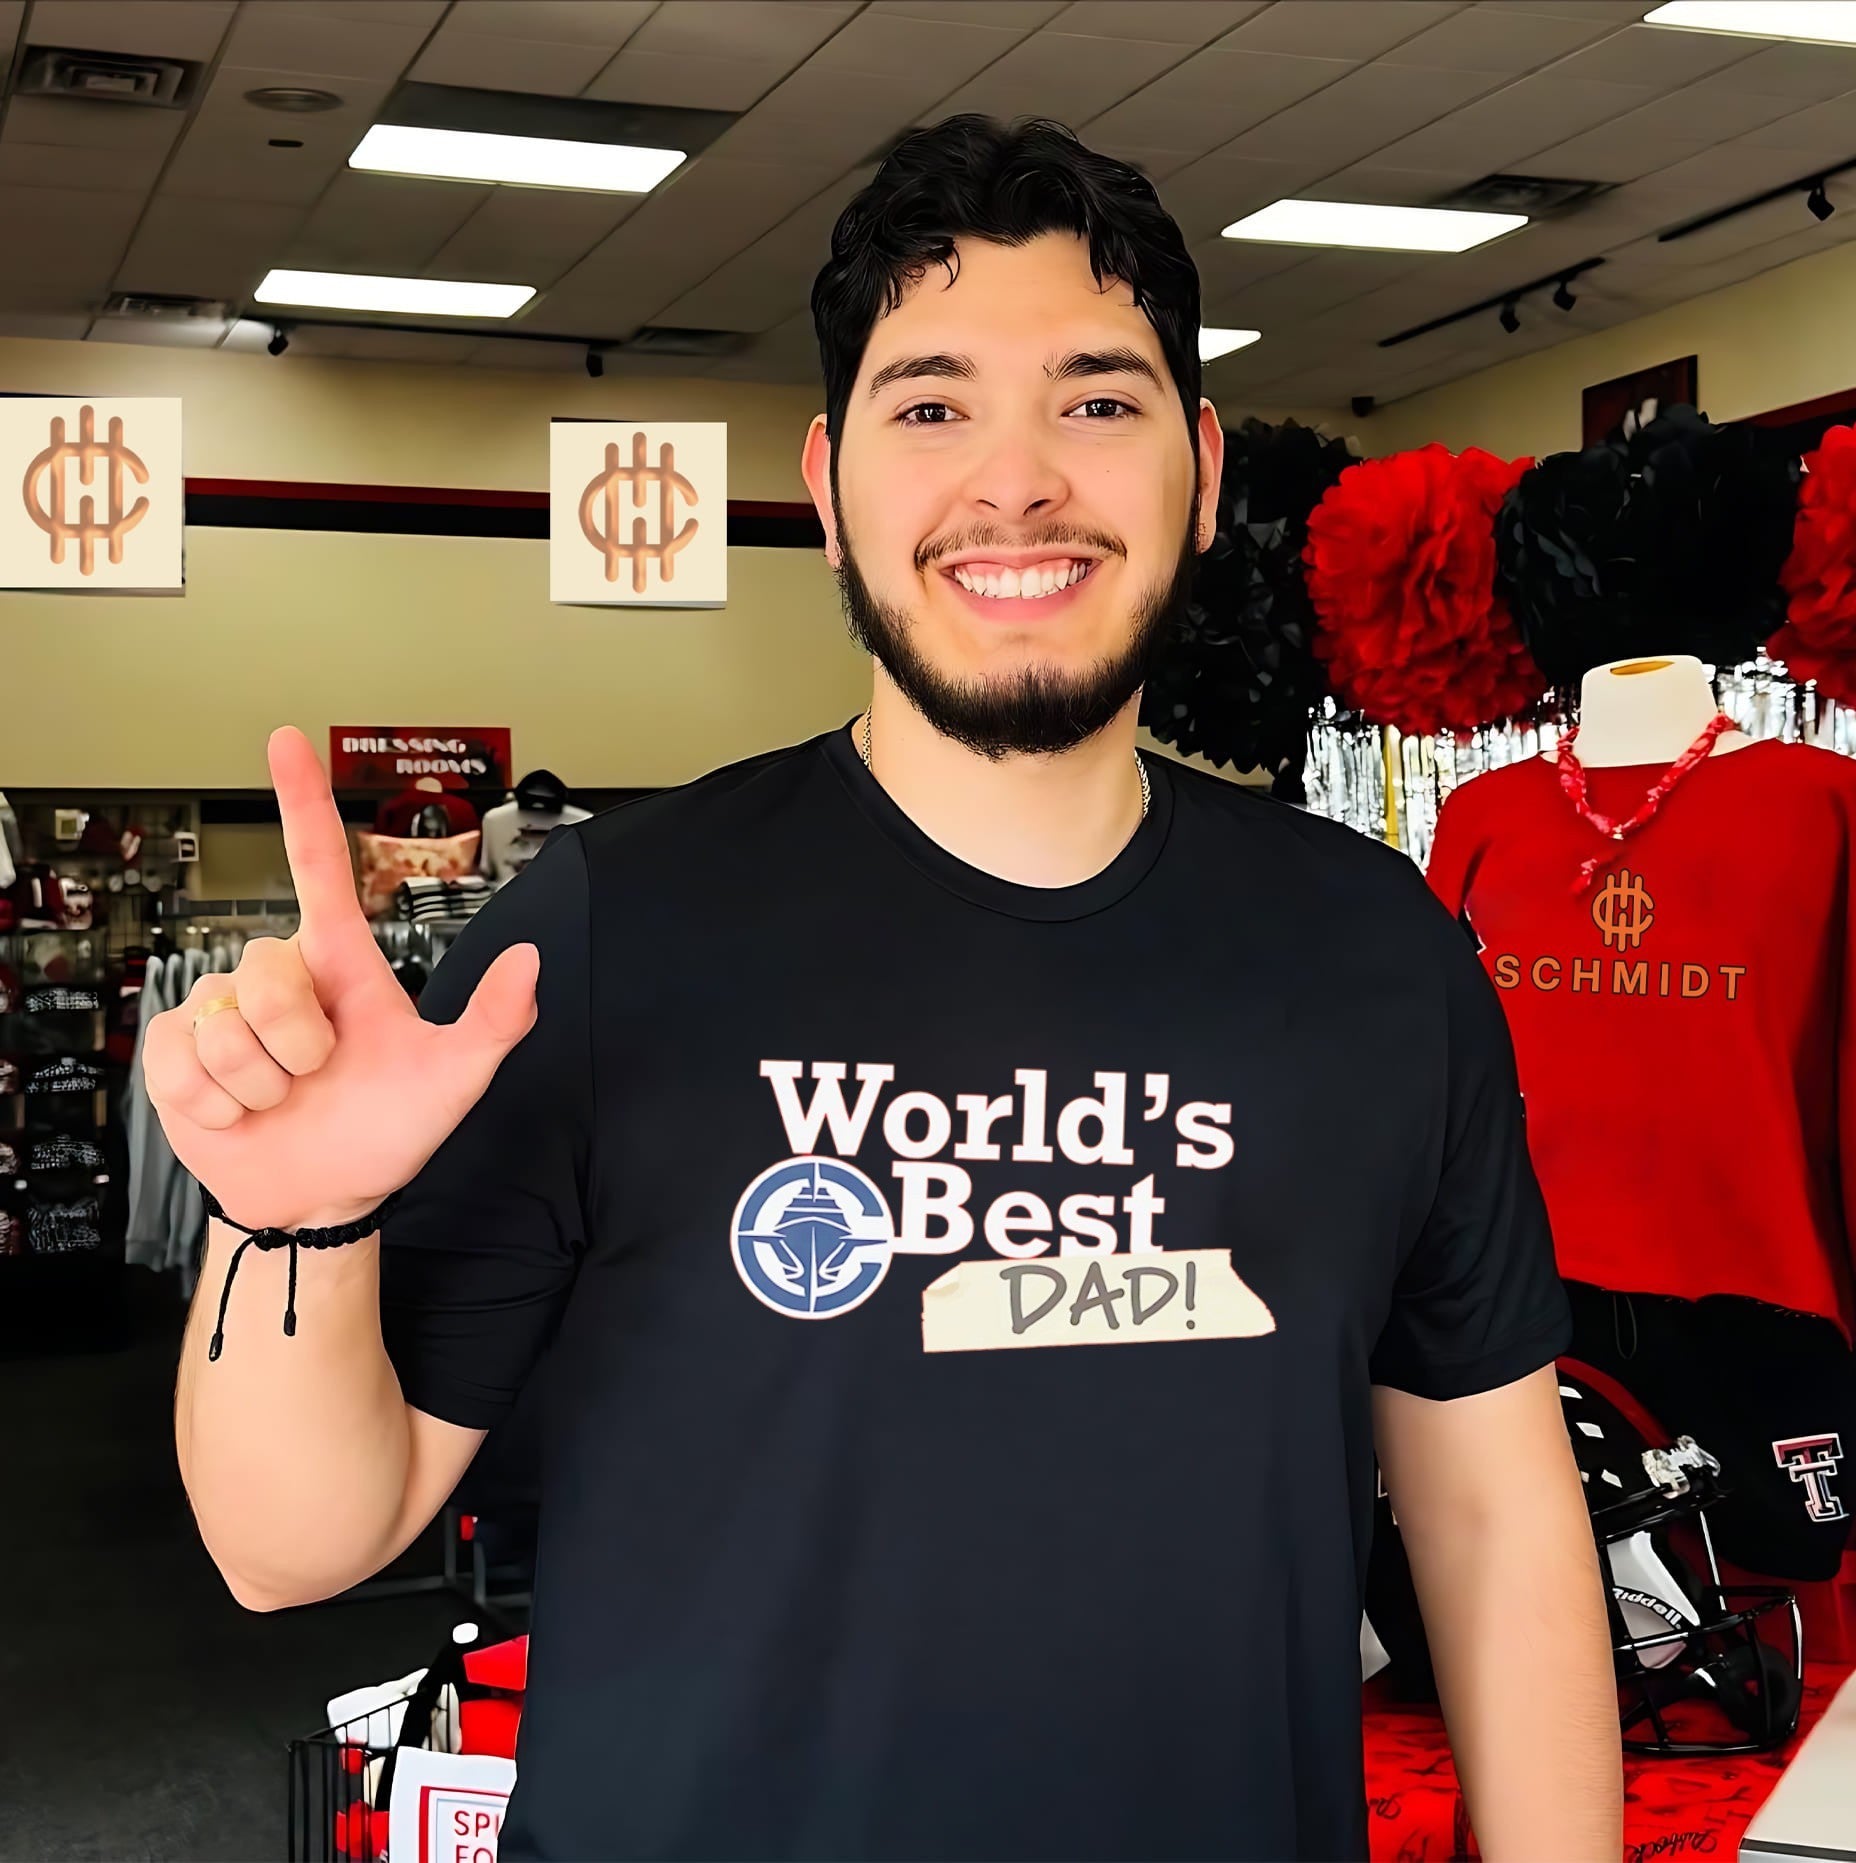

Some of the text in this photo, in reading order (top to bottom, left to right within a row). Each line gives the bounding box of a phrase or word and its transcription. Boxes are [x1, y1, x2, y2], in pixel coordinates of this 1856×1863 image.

[342, 737, 467, 754] DRESSING
[396, 759, 487, 775] ROOMS
[1494, 953, 1746, 1000] SCHMIDT
[760, 1060, 1235, 1170] World's
[892, 1160, 1165, 1260] Best
[999, 1260, 1196, 1335] DAD!
